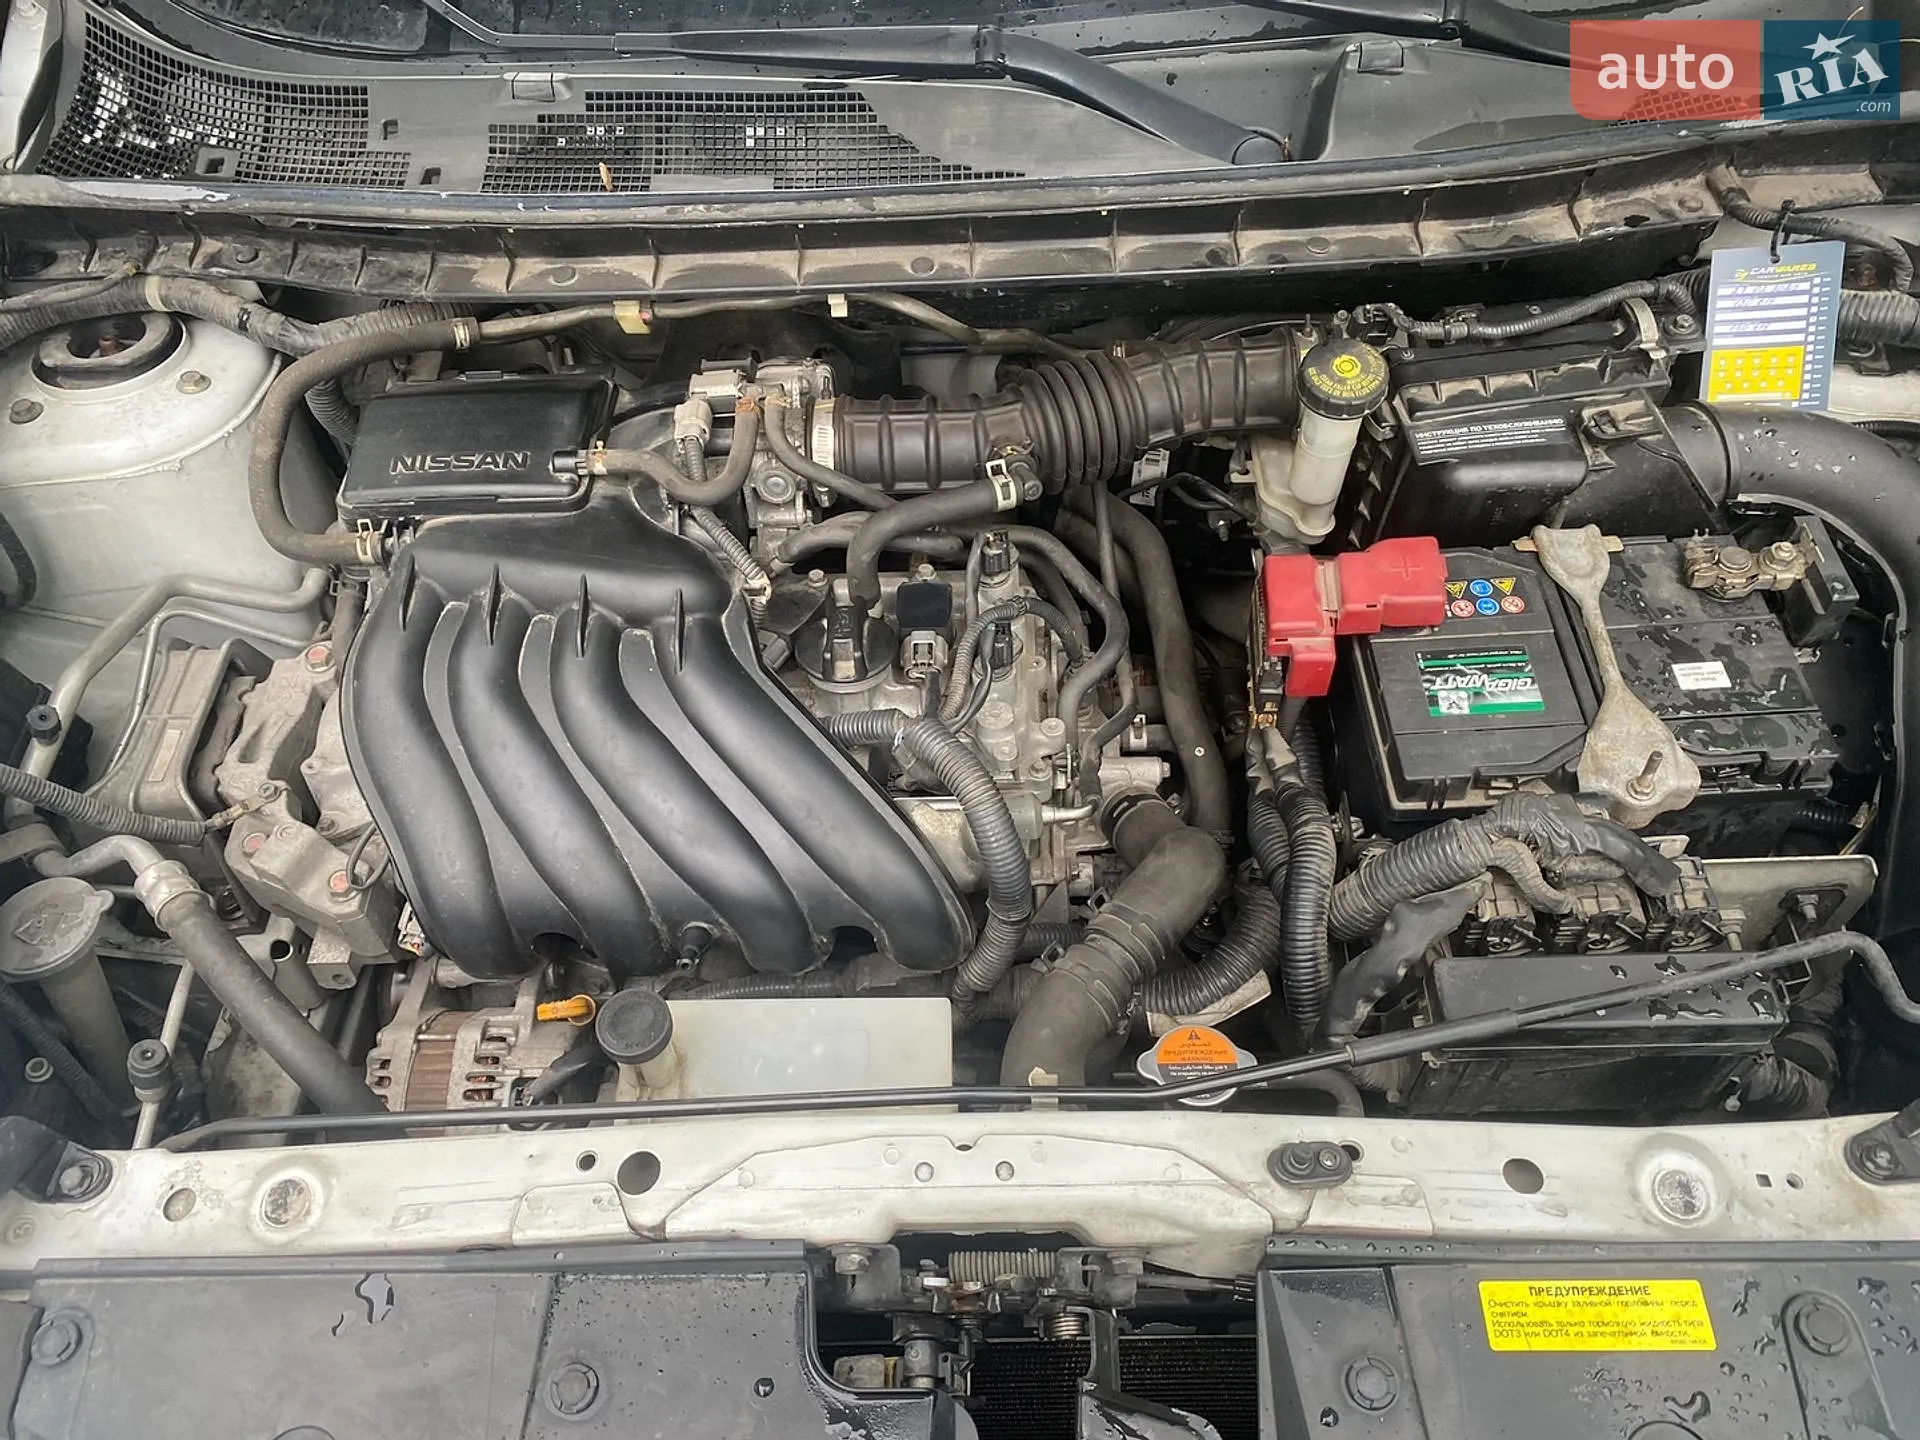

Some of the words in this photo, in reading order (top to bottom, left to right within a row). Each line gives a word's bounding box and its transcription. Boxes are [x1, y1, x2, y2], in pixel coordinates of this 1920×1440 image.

[389, 451, 531, 474] NISSAN
[1432, 673, 1534, 692] GIGAWATT
[1529, 1285, 1652, 1298] ПРЕДУПРЕЖДЕНИЕ
[1494, 1329, 1522, 1338] DOT3
[1543, 1329, 1571, 1338] DOT4
